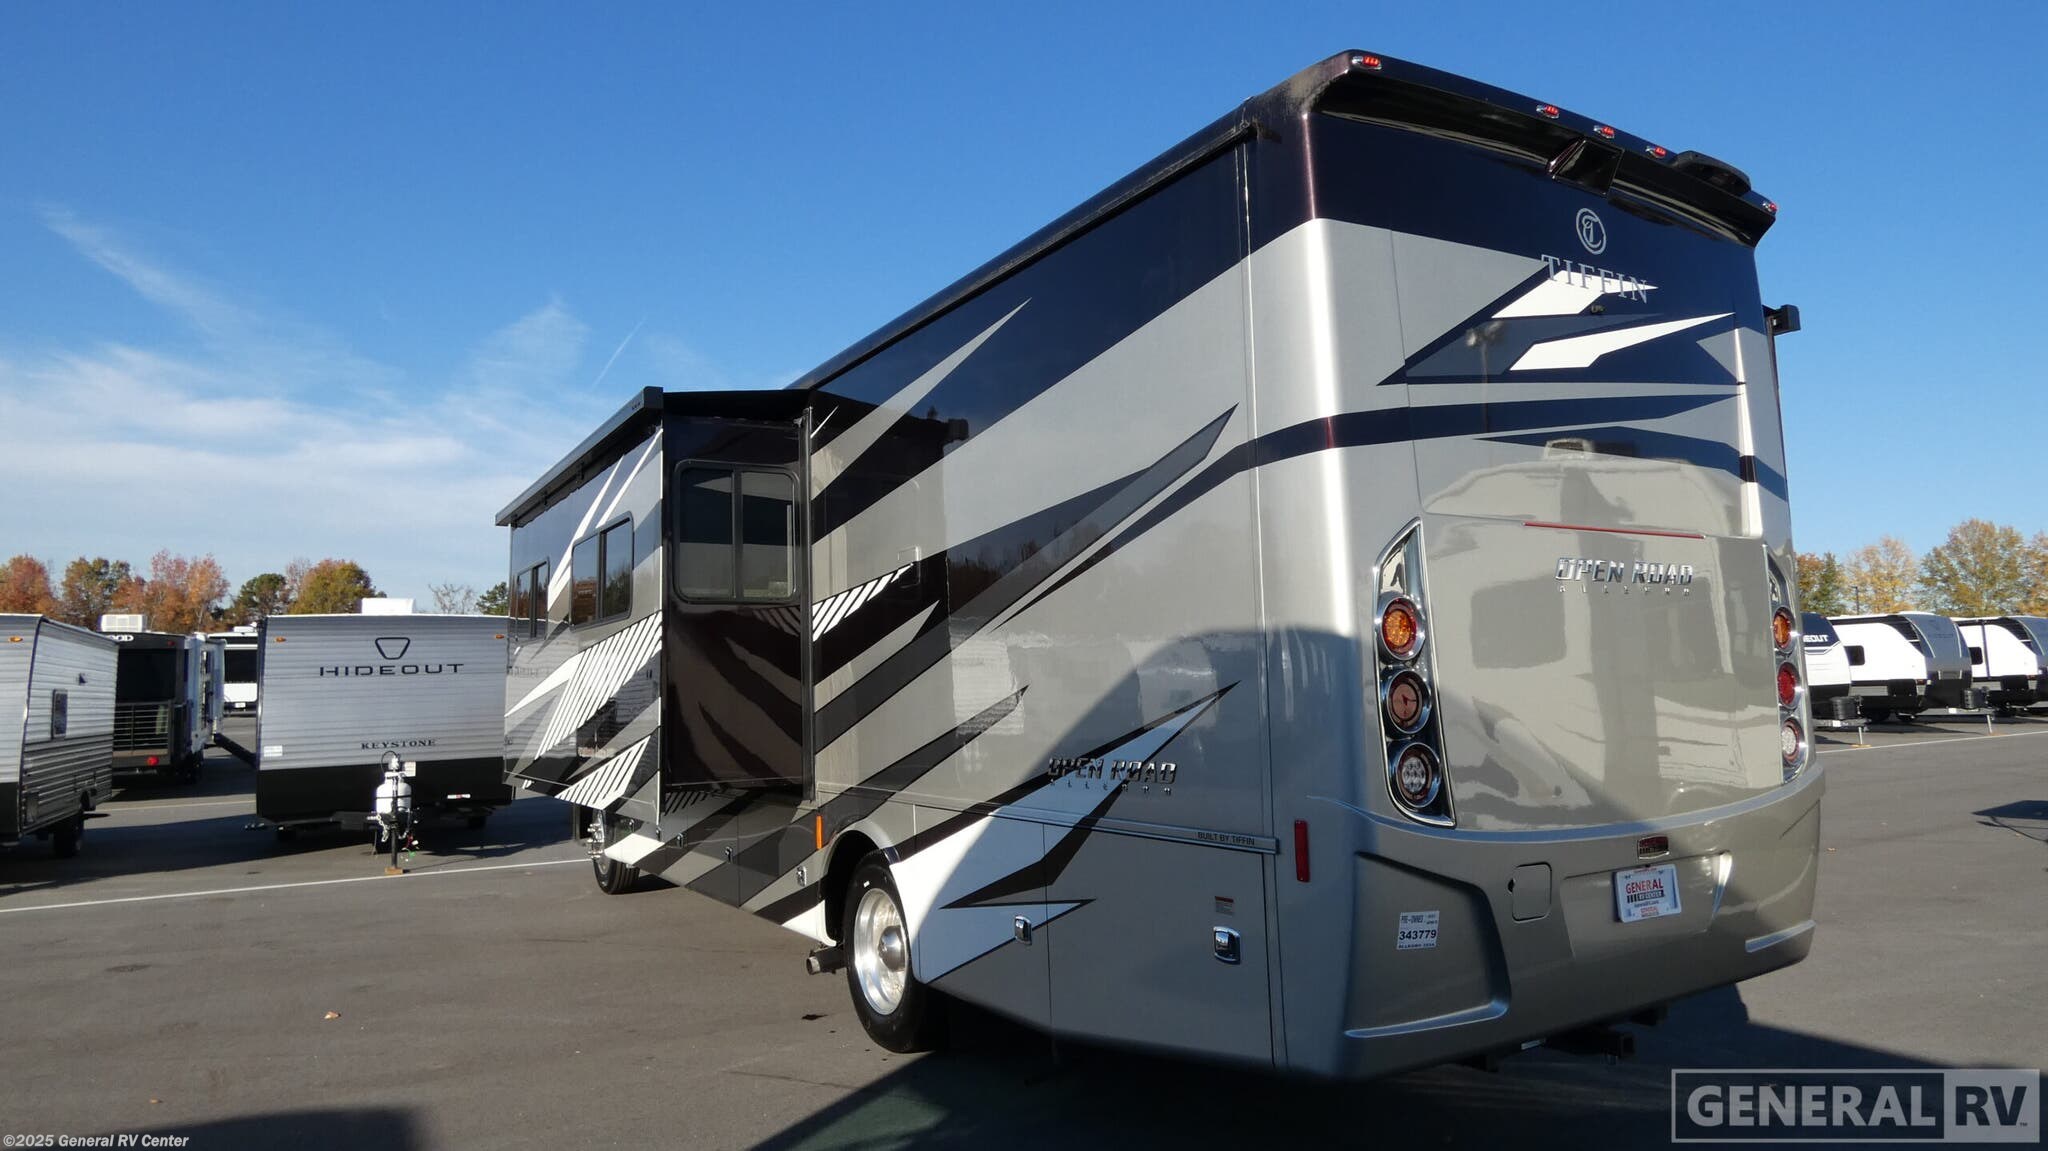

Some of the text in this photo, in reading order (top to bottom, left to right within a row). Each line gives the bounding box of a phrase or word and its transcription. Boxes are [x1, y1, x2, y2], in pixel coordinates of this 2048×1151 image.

[1541, 254, 1647, 304] TIFFIN
[1555, 557, 1693, 586] OPEN ROAD
[320, 663, 464, 677] HIDEOUT
[361, 738, 436, 750] KEYSTONE
[1048, 758, 1177, 785] OPEN ROAD
[1198, 831, 1255, 846] BUILT BY TIFFIN
[1625, 878, 1664, 894] GENERAL
[1399, 929, 1437, 941] 343779
